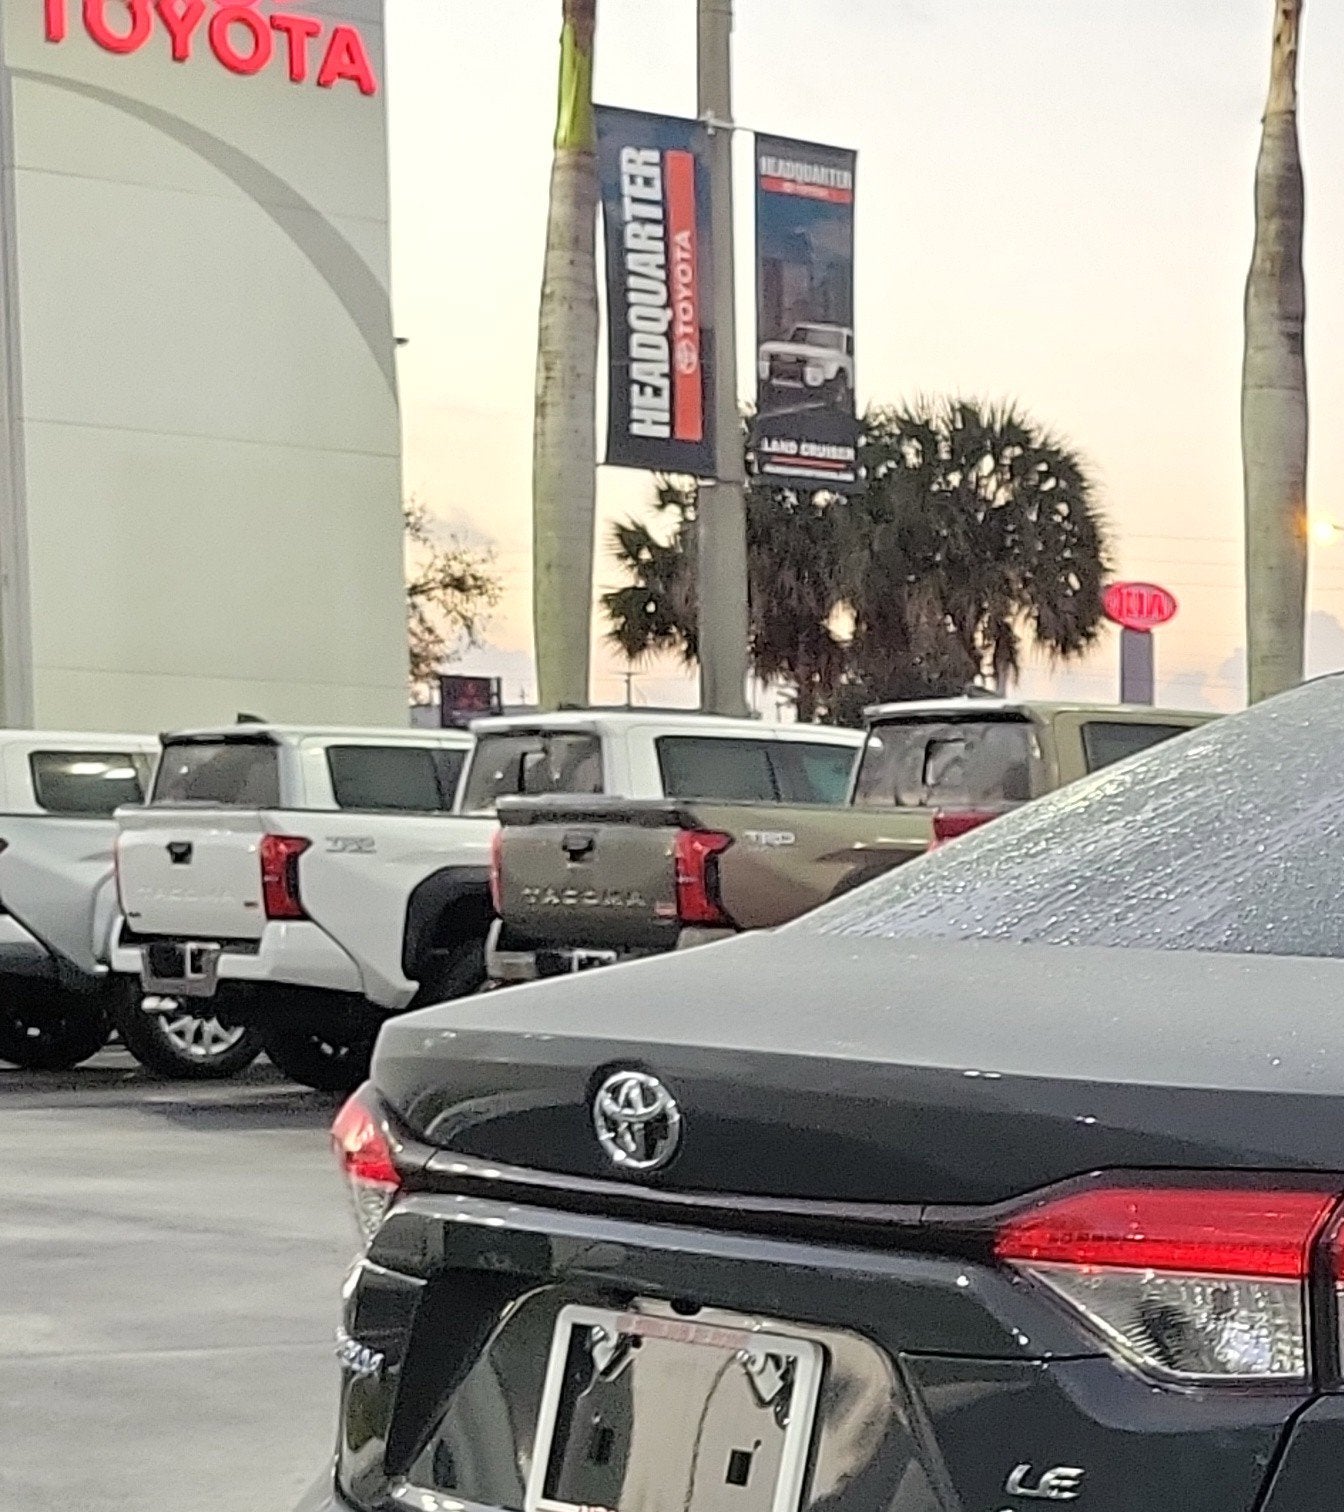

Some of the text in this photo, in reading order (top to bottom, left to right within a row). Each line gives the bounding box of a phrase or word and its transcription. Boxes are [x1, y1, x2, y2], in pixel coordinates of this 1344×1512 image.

[43, 0, 376, 96] TOYOTA
[620, 146, 673, 440] HEADQUARTER
[674, 230, 694, 336] TOYOTA
[1005, 1463, 1086, 1499] LE
